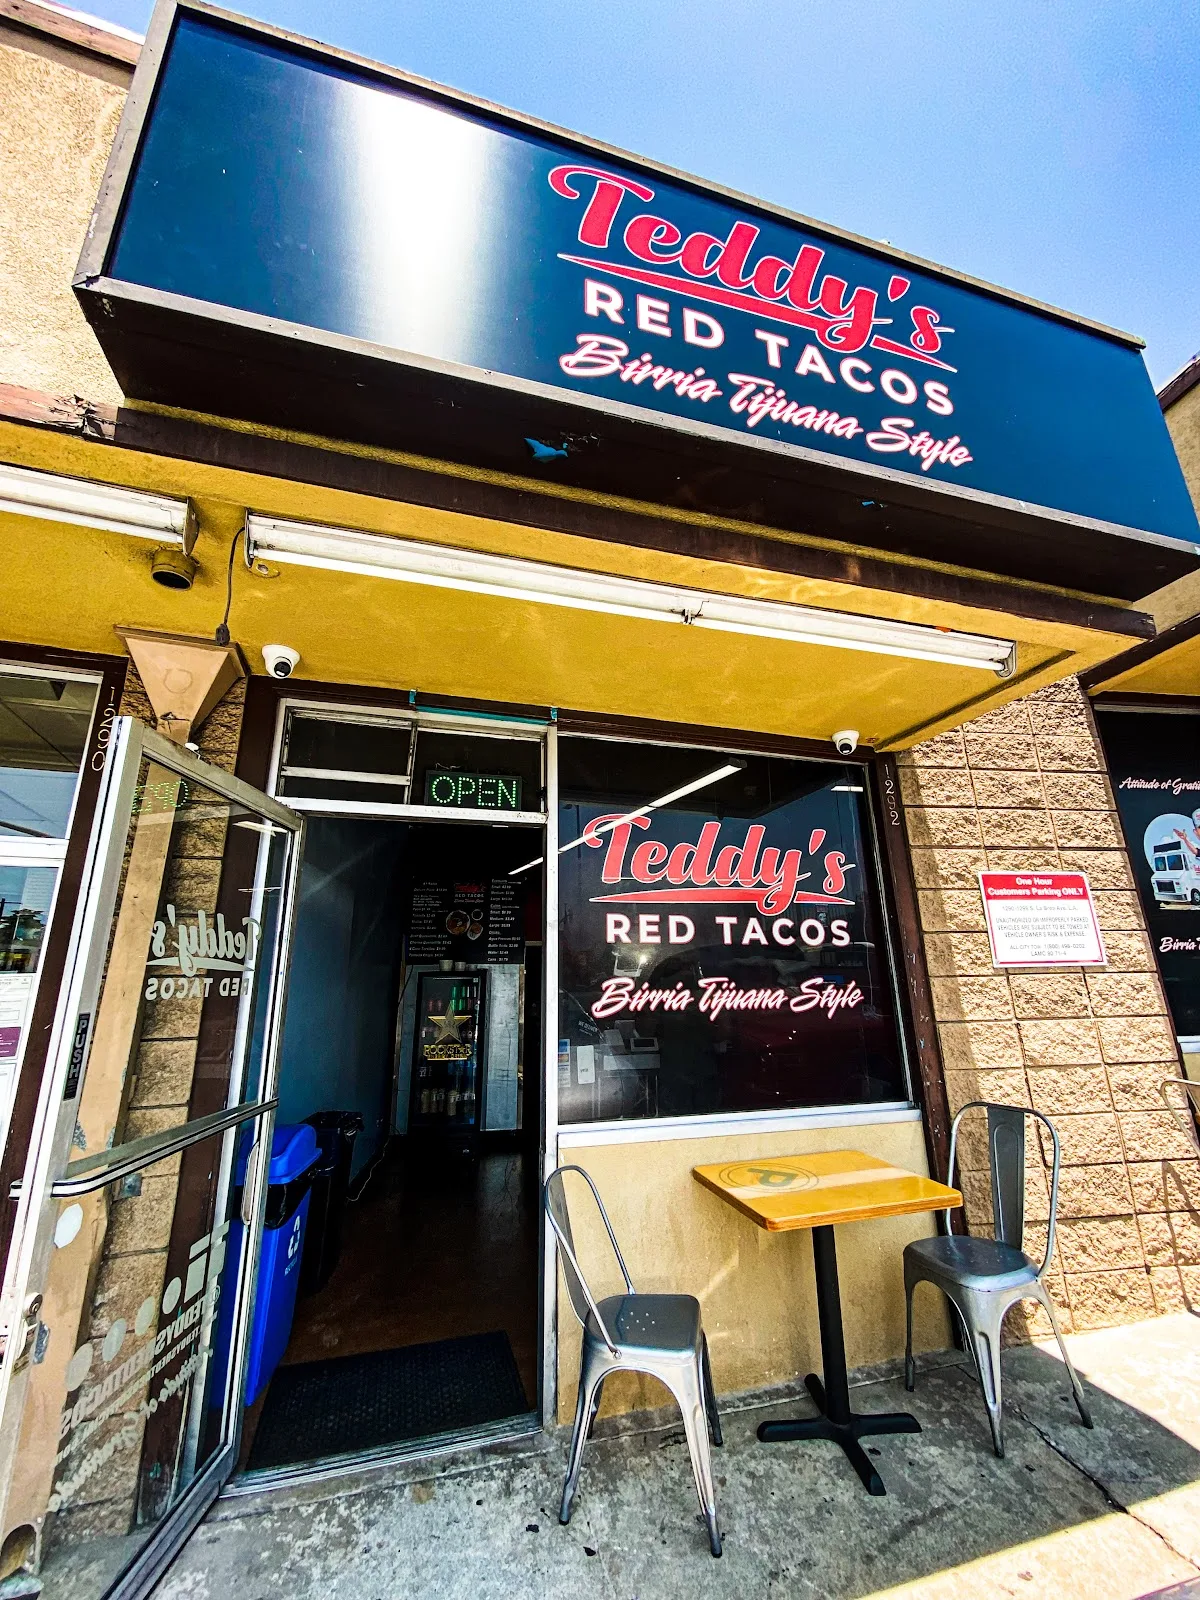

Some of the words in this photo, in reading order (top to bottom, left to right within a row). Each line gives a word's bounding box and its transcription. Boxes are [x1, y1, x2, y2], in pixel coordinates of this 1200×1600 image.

[548, 164, 955, 354] Teddy's
[584, 278, 724, 349] RED
[754, 328, 955, 416] TACOS
[559, 333, 723, 402] Birria
[727, 370, 863, 439] Tijuana
[866, 417, 973, 471] Style
[432, 775, 516, 808] OPEN
[884, 764, 900, 826] 1292
[1119, 777, 1160, 790] Attitude
[1161, 779, 1171, 789] of
[1172, 777, 1200, 795] Grati
[583, 813, 855, 916] Teddy's
[1016, 877, 1033, 886] One
[1034, 877, 1053, 886] Hour
[988, 888, 1031, 896] Customers
[1032, 888, 1062, 897] Parking
[1062, 888, 1084, 896] ONLY
[606, 913, 696, 944] RED
[715, 916, 850, 947] TACOS
[1159, 936, 1197, 952] Birria
[591, 976, 694, 1018] Birria
[697, 976, 787, 1021] Tijuana
[790, 976, 864, 1019] Style
[69, 1020, 88, 1079] PUSH
